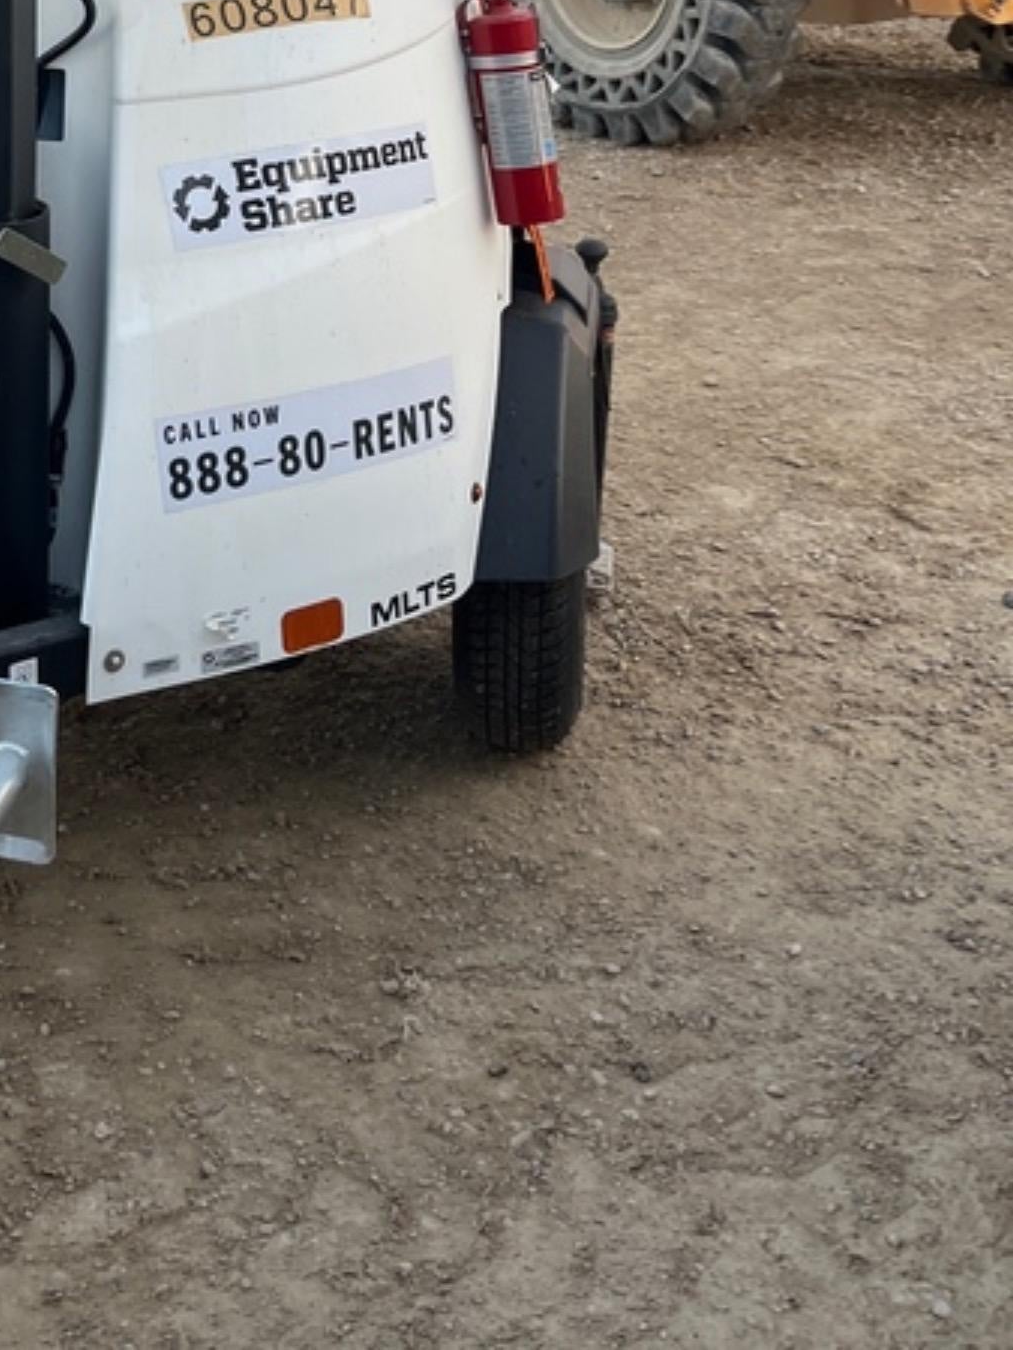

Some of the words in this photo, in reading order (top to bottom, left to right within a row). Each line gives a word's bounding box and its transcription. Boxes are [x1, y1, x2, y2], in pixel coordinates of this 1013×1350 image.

[231, 130, 428, 193] Equipment
[240, 188, 357, 233] Share
[163, 418, 220, 445] CALL
[232, 404, 281, 433] NOW
[168, 394, 455, 501] 888-80-RENTS
[370, 572, 458, 627] MLTS
